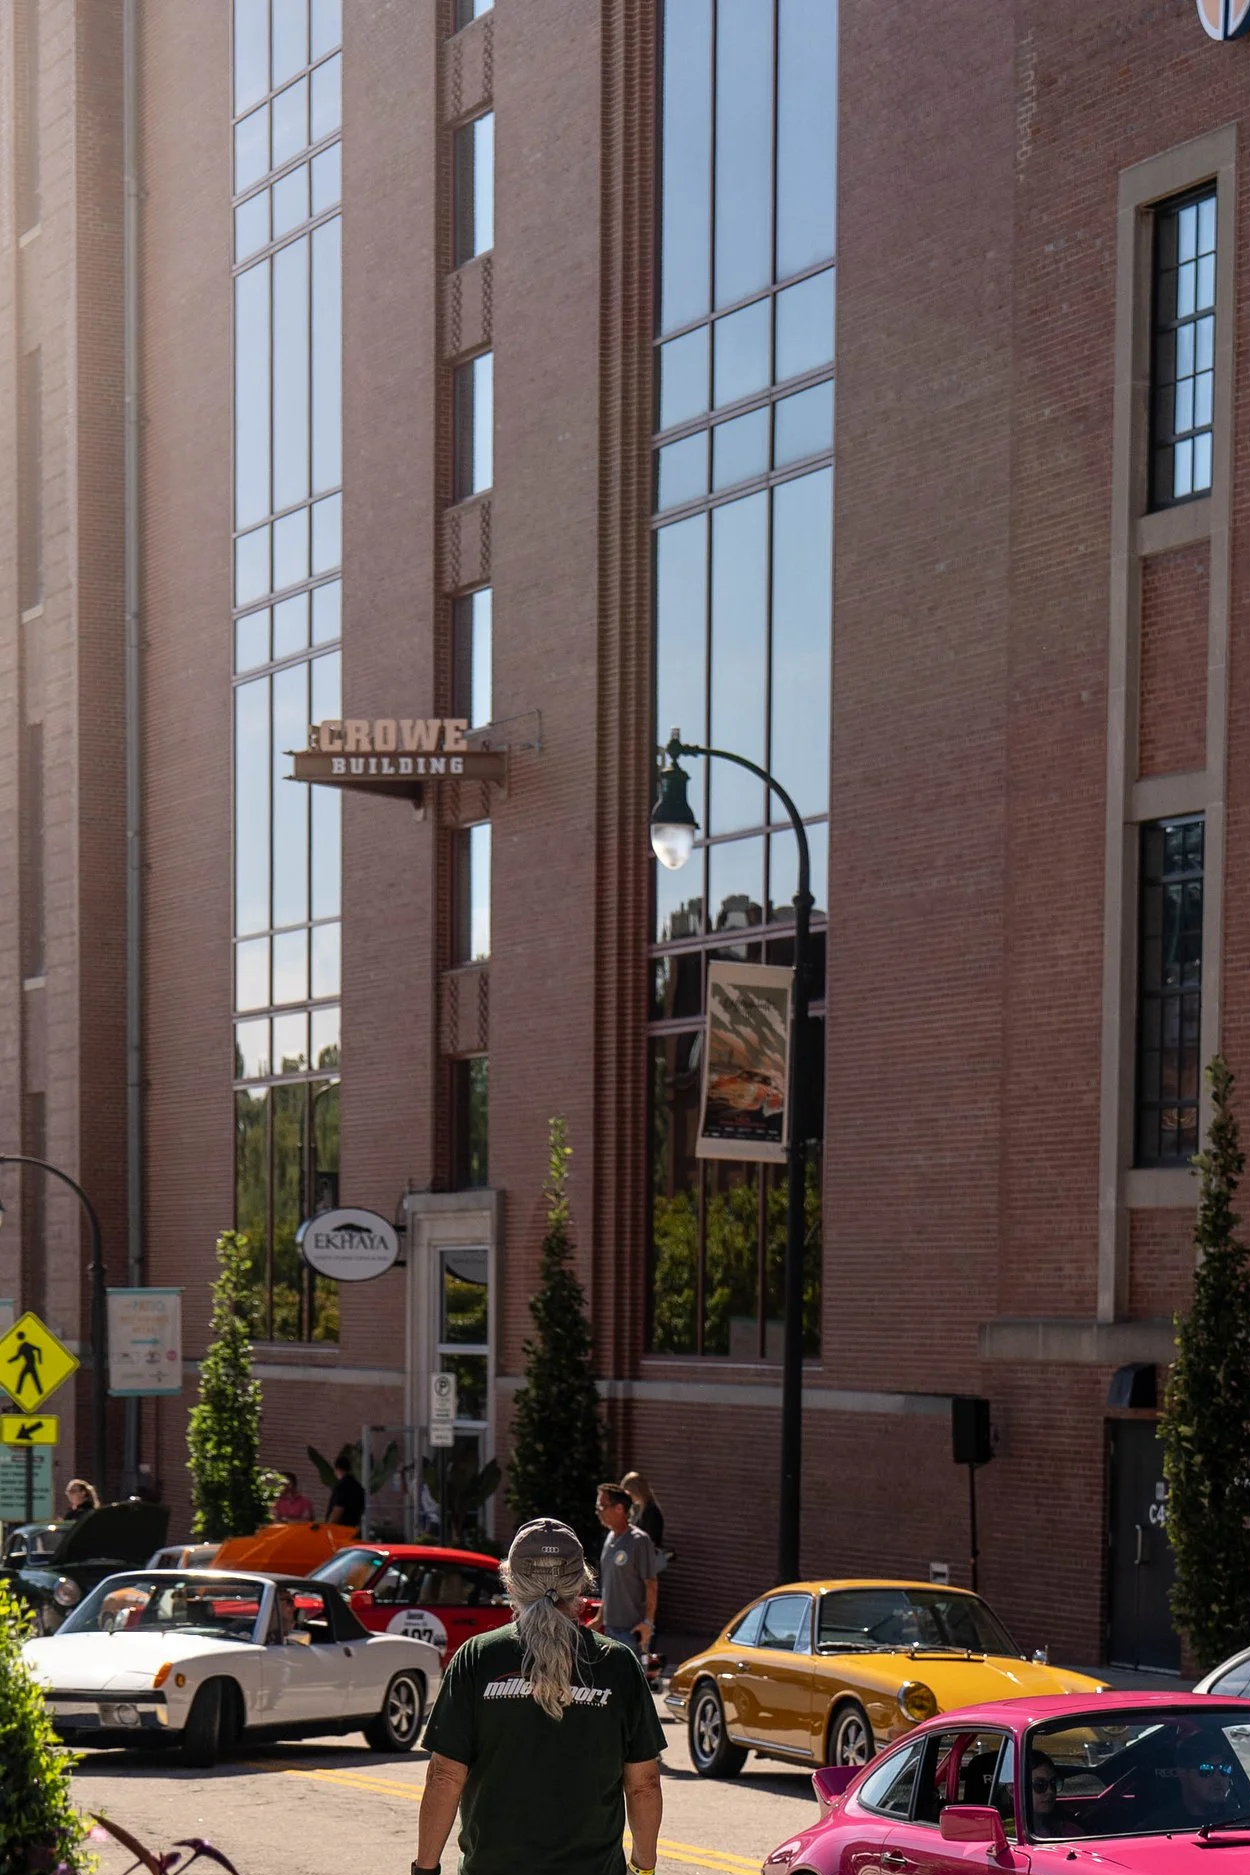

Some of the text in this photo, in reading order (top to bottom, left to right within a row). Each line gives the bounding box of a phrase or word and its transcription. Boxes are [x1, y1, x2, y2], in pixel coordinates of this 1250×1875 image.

[319, 718, 468, 752] CROWE
[331, 757, 465, 775] BUILDING
[313, 1232, 389, 1250] EKHAYA
